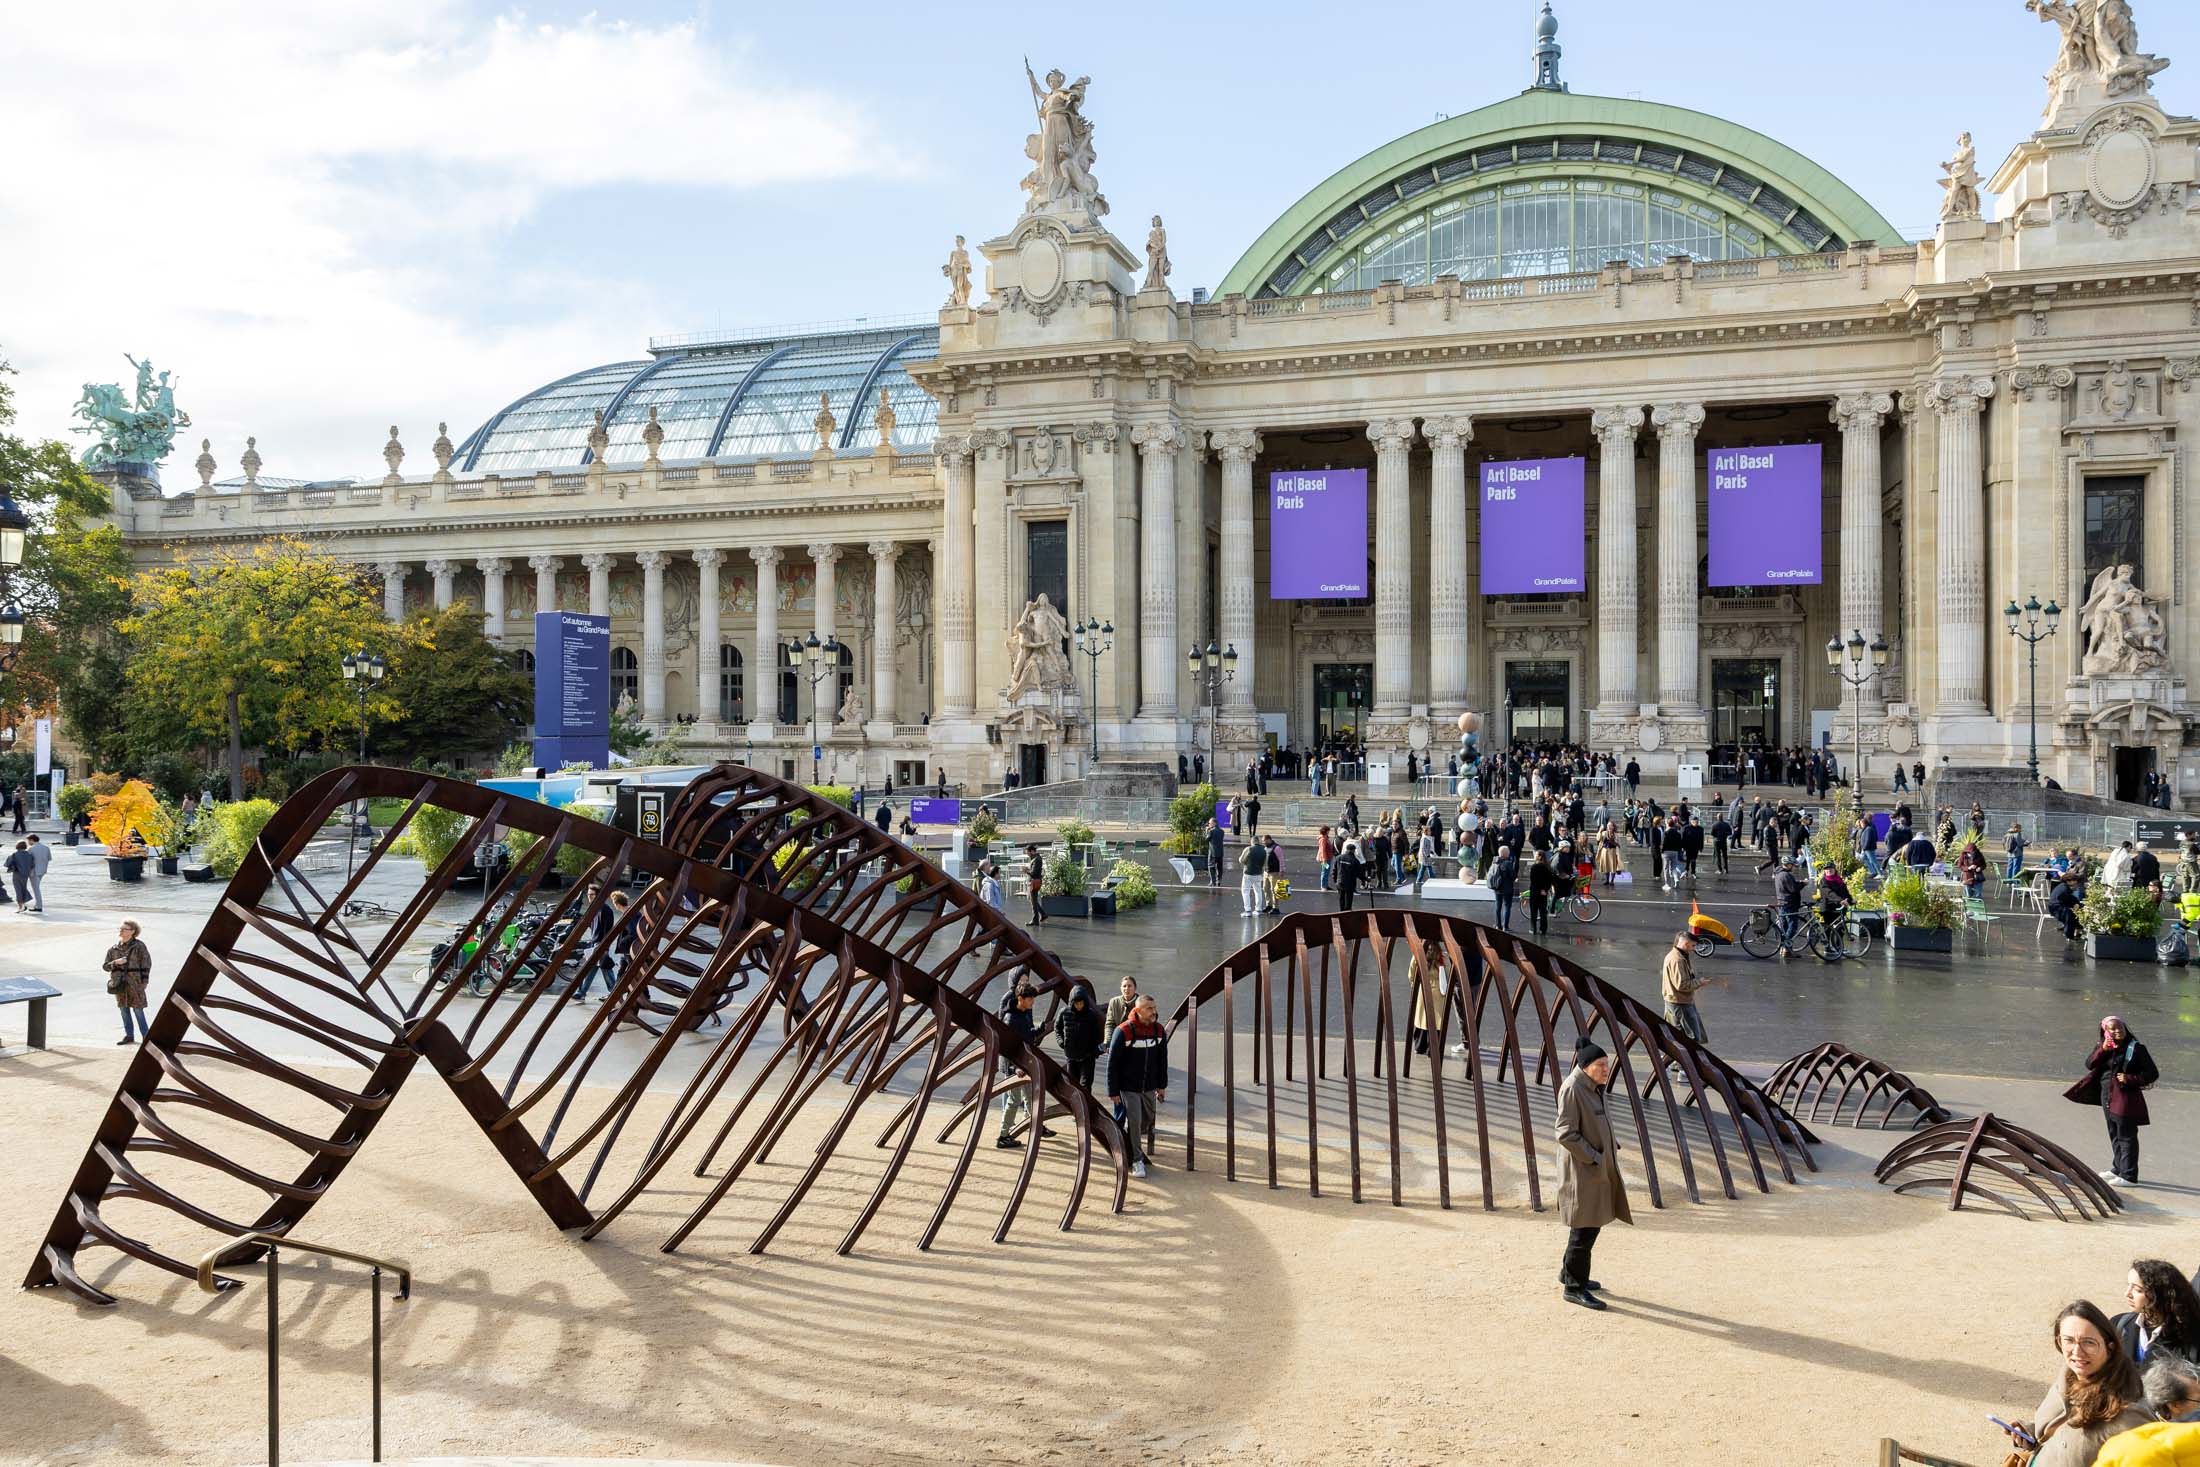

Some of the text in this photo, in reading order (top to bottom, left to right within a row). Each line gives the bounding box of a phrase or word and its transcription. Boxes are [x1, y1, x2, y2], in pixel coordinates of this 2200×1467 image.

[1715, 453, 1773, 470] Art Basel
[1487, 466, 1540, 483] Art Basel
[1715, 474, 1747, 490] Paris
[1276, 476, 1327, 492] Art Basel
[1487, 486, 1516, 501] Paris
[1276, 495, 1304, 510] Paris
[572, 618, 592, 626] automne
